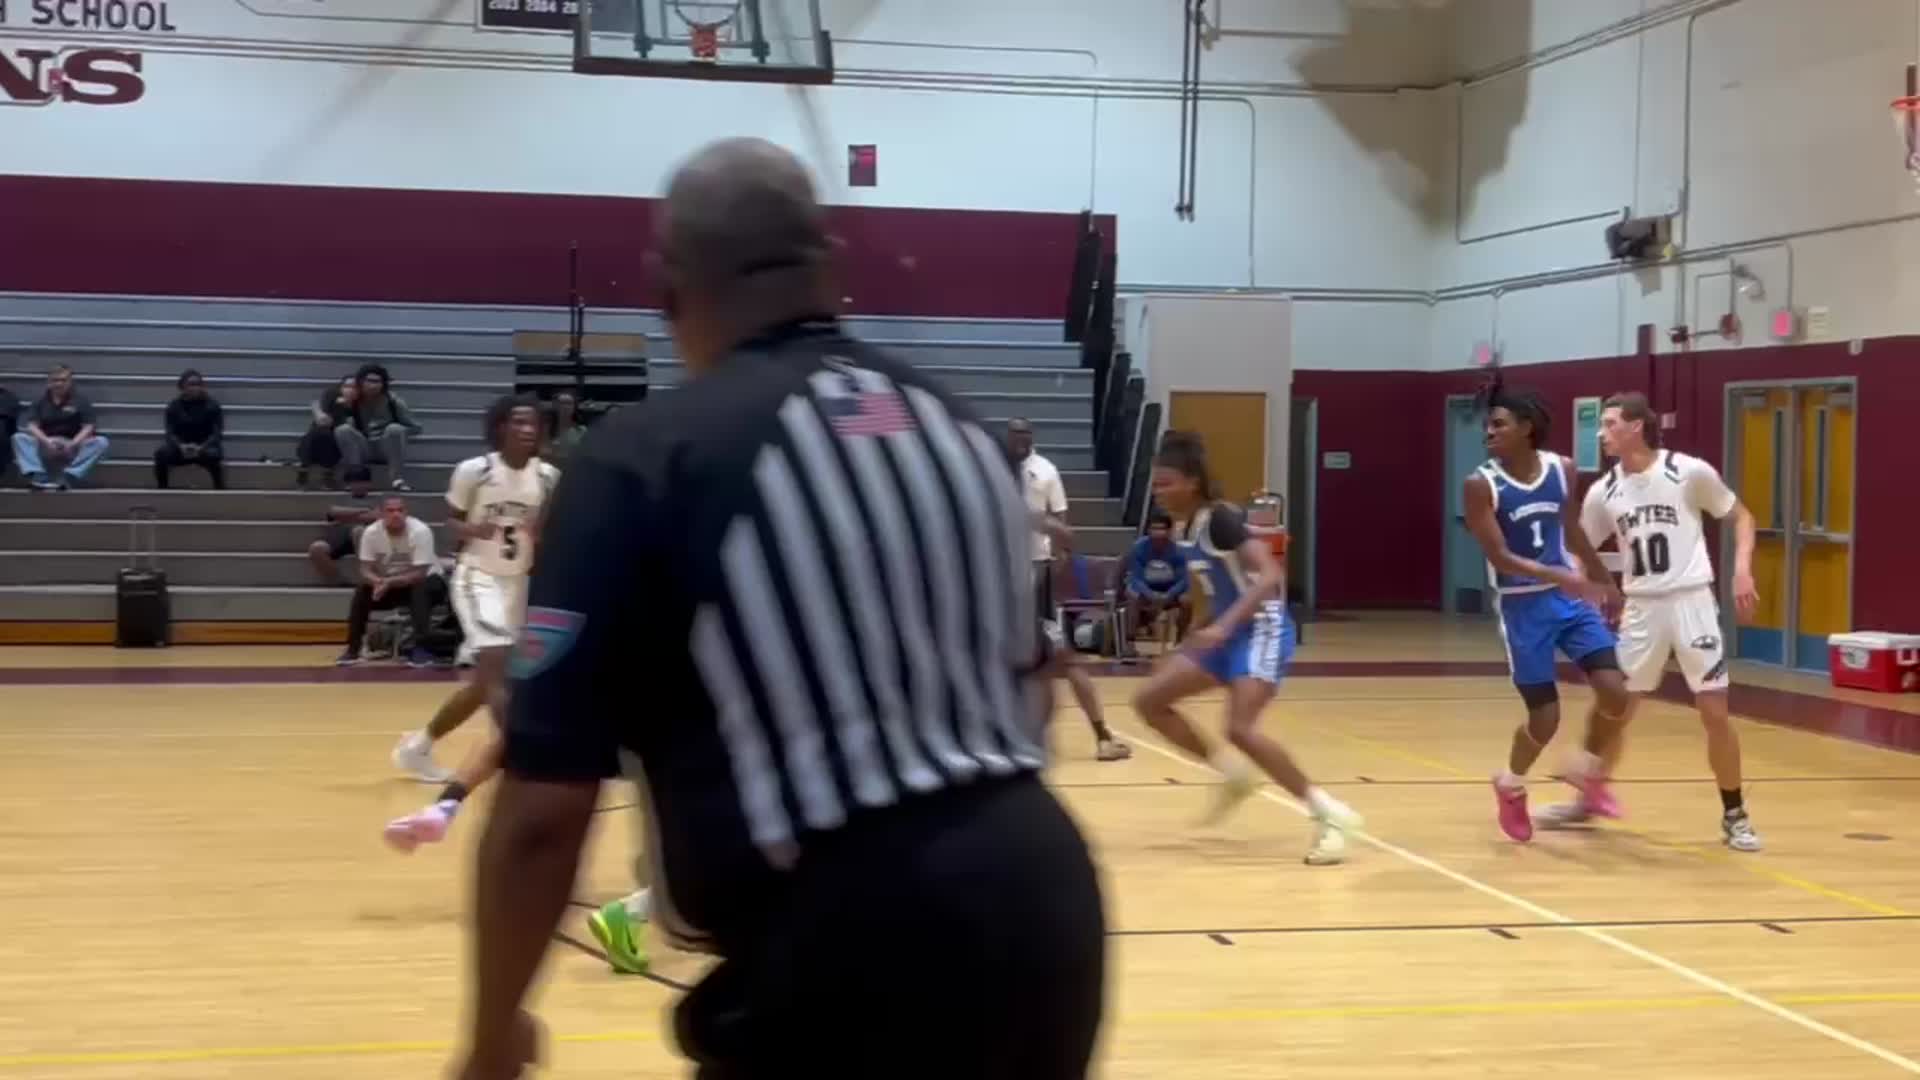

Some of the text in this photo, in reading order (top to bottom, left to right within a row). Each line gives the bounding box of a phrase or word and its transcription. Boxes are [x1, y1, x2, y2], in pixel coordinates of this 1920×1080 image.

[32, 0, 176, 31] SCHOOL
[502, 525, 520, 560] 5
[1530, 519, 1544, 547] 1
[1631, 532, 1670, 576] 10
